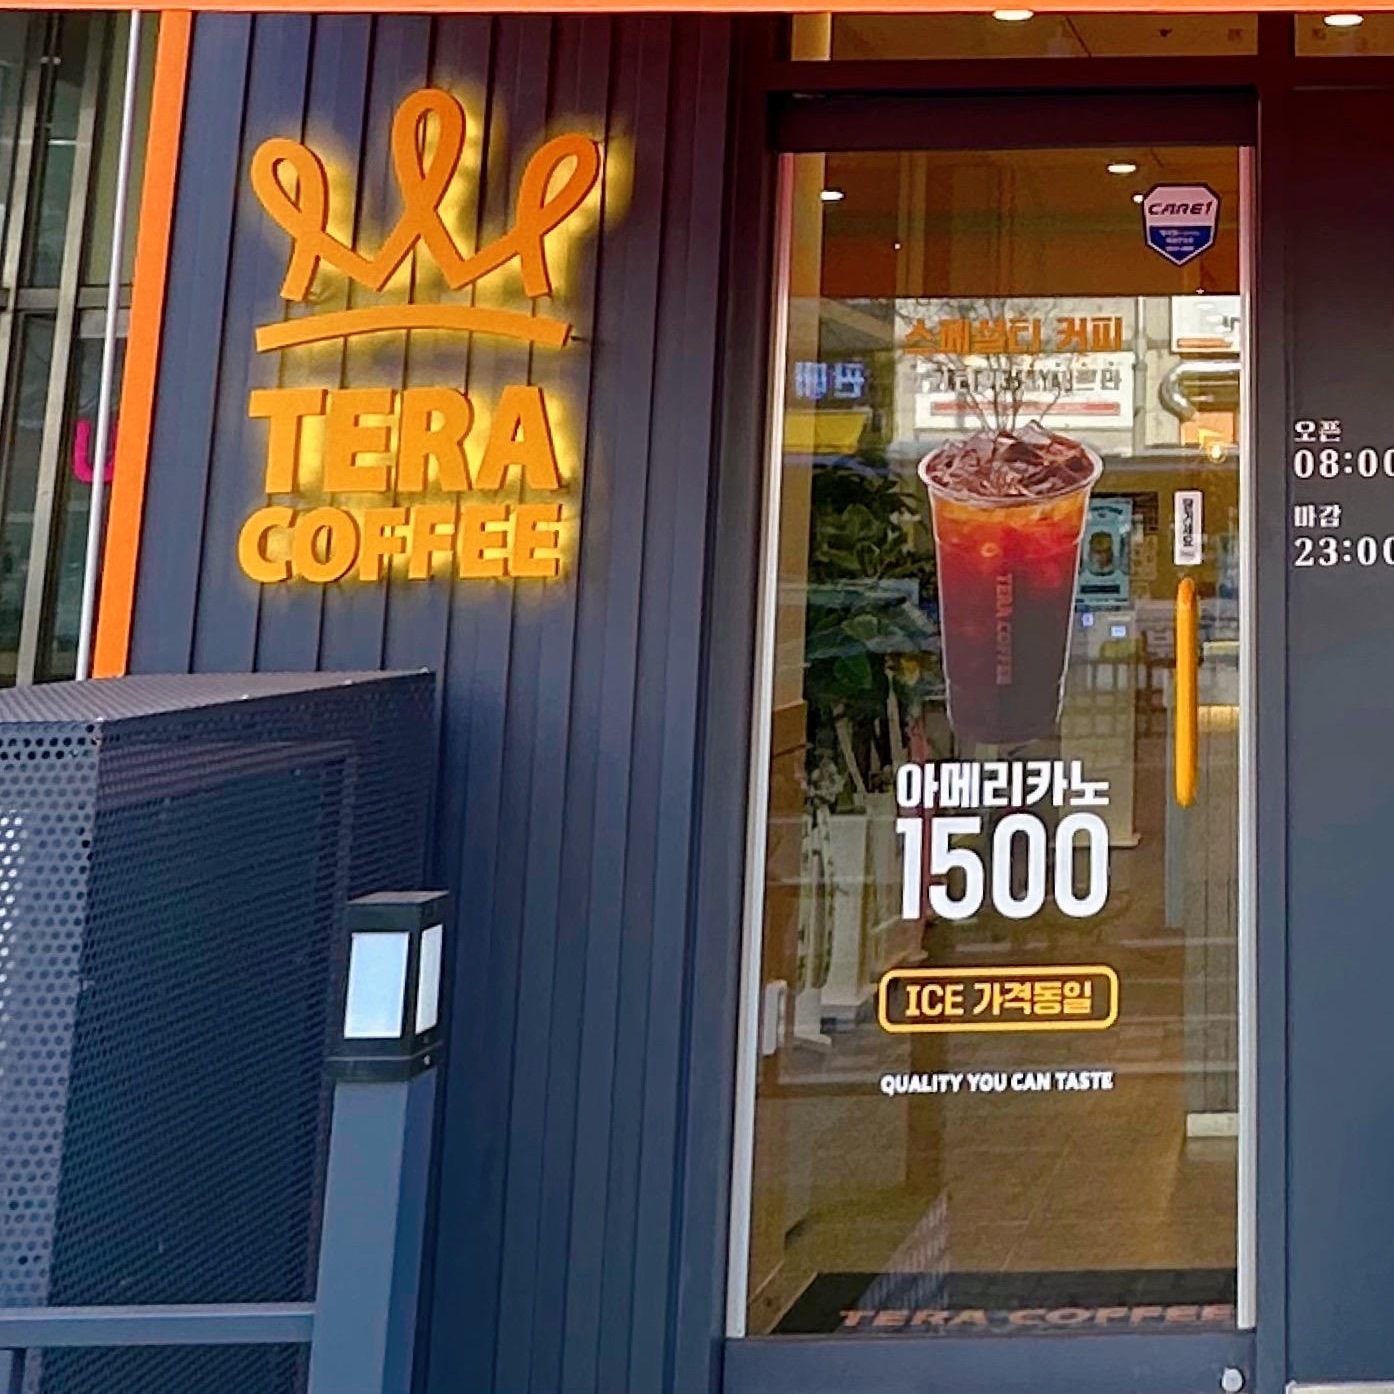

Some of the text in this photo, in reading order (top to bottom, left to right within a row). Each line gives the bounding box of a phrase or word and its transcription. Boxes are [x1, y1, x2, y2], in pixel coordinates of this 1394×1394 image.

[1055, 315, 1124, 353] 커피
[248, 384, 562, 494] TERA
[1293, 419, 1342, 443] 오픈
[1293, 503, 1342, 528] 마감
[237, 504, 562, 583] COFFEE
[896, 760, 1110, 808] 아메리카노
[895, 811, 1110, 919] 1500
[905, 980, 1093, 1017] ICE 가격동일
[881, 1071, 1114, 1096] QUALITY YOU CAN TASTE
[839, 1304, 1233, 1328] TERA COFFEE
